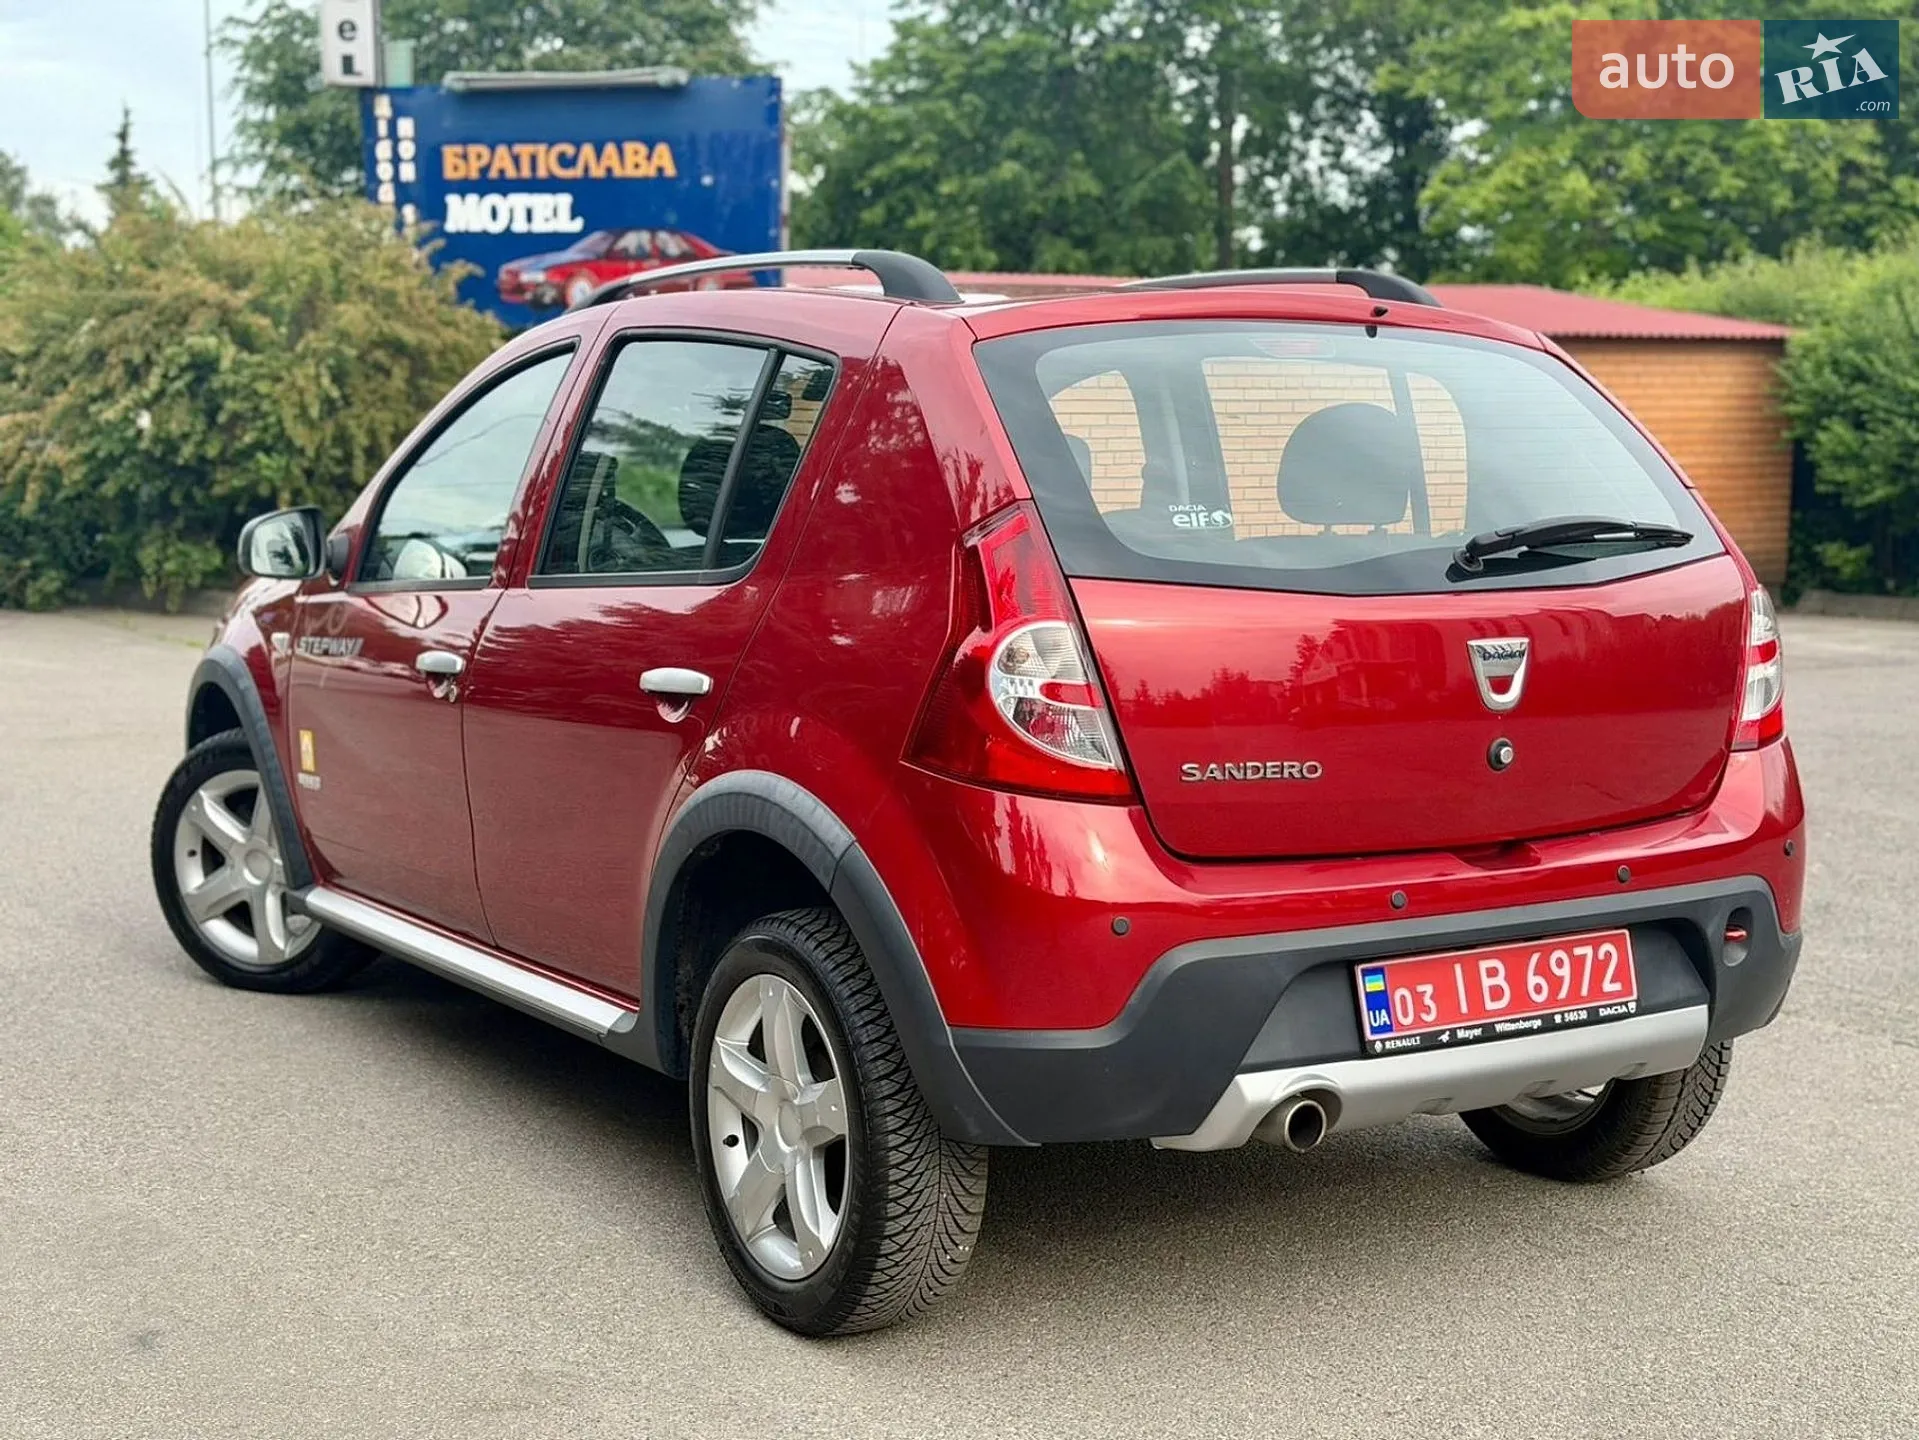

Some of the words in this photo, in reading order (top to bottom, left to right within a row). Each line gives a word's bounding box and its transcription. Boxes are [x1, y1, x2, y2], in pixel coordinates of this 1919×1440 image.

[441, 141, 677, 180] БРАТІСЛАВА
[444, 192, 585, 234] MOTEL
[1180, 761, 1323, 782] SANDERO
[1369, 1009, 1391, 1027] UA
[1393, 983, 1438, 1026] 03
[1526, 942, 1622, 1003] 6972
[1385, 1036, 1421, 1050] RENAULT
[1456, 1027, 1483, 1040] Mayer
[1495, 1018, 1543, 1033] Wittenberge
